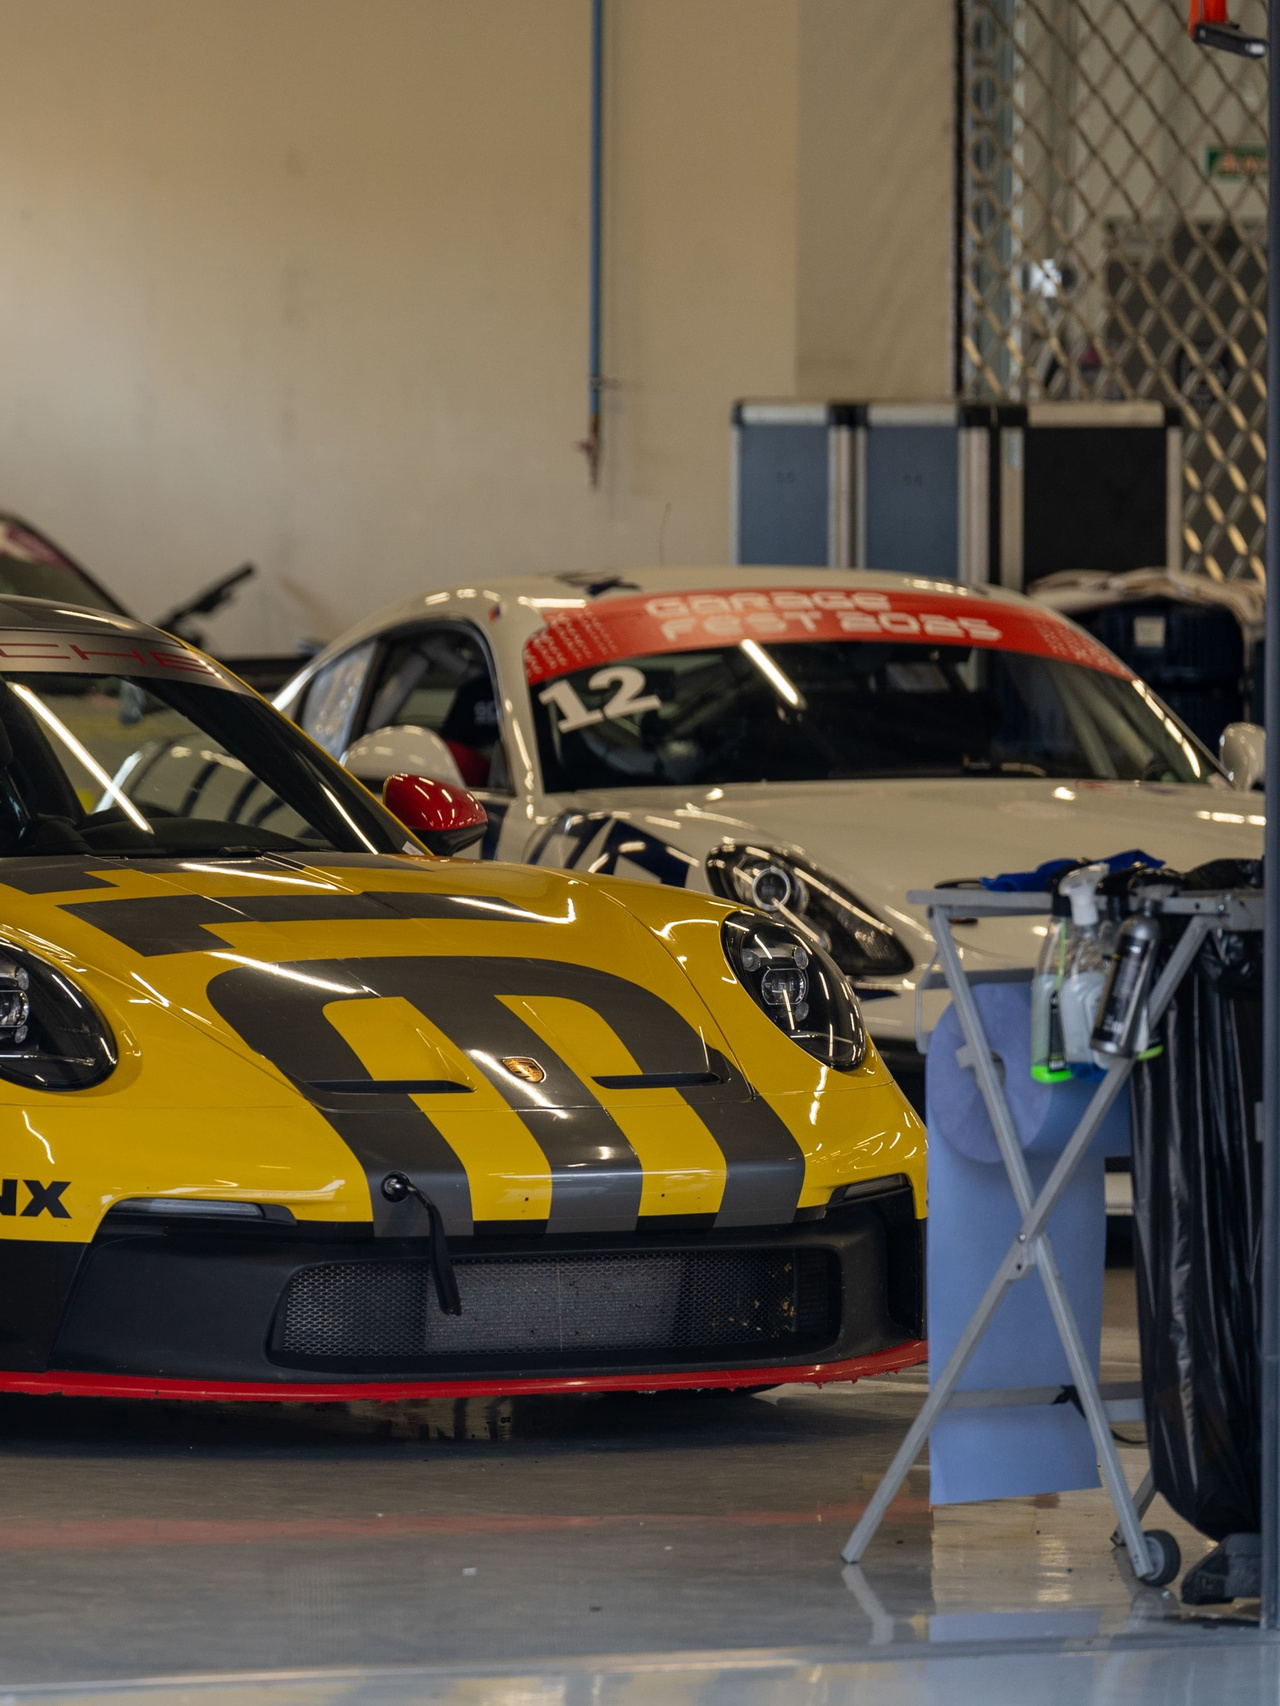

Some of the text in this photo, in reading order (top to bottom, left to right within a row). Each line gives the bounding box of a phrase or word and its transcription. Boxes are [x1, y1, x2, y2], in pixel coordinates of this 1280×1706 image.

[644, 590, 893, 619] GARAGE
[660, 610, 823, 643] FEST
[835, 610, 1004, 643] 2025
[538, 665, 662, 734] 12
